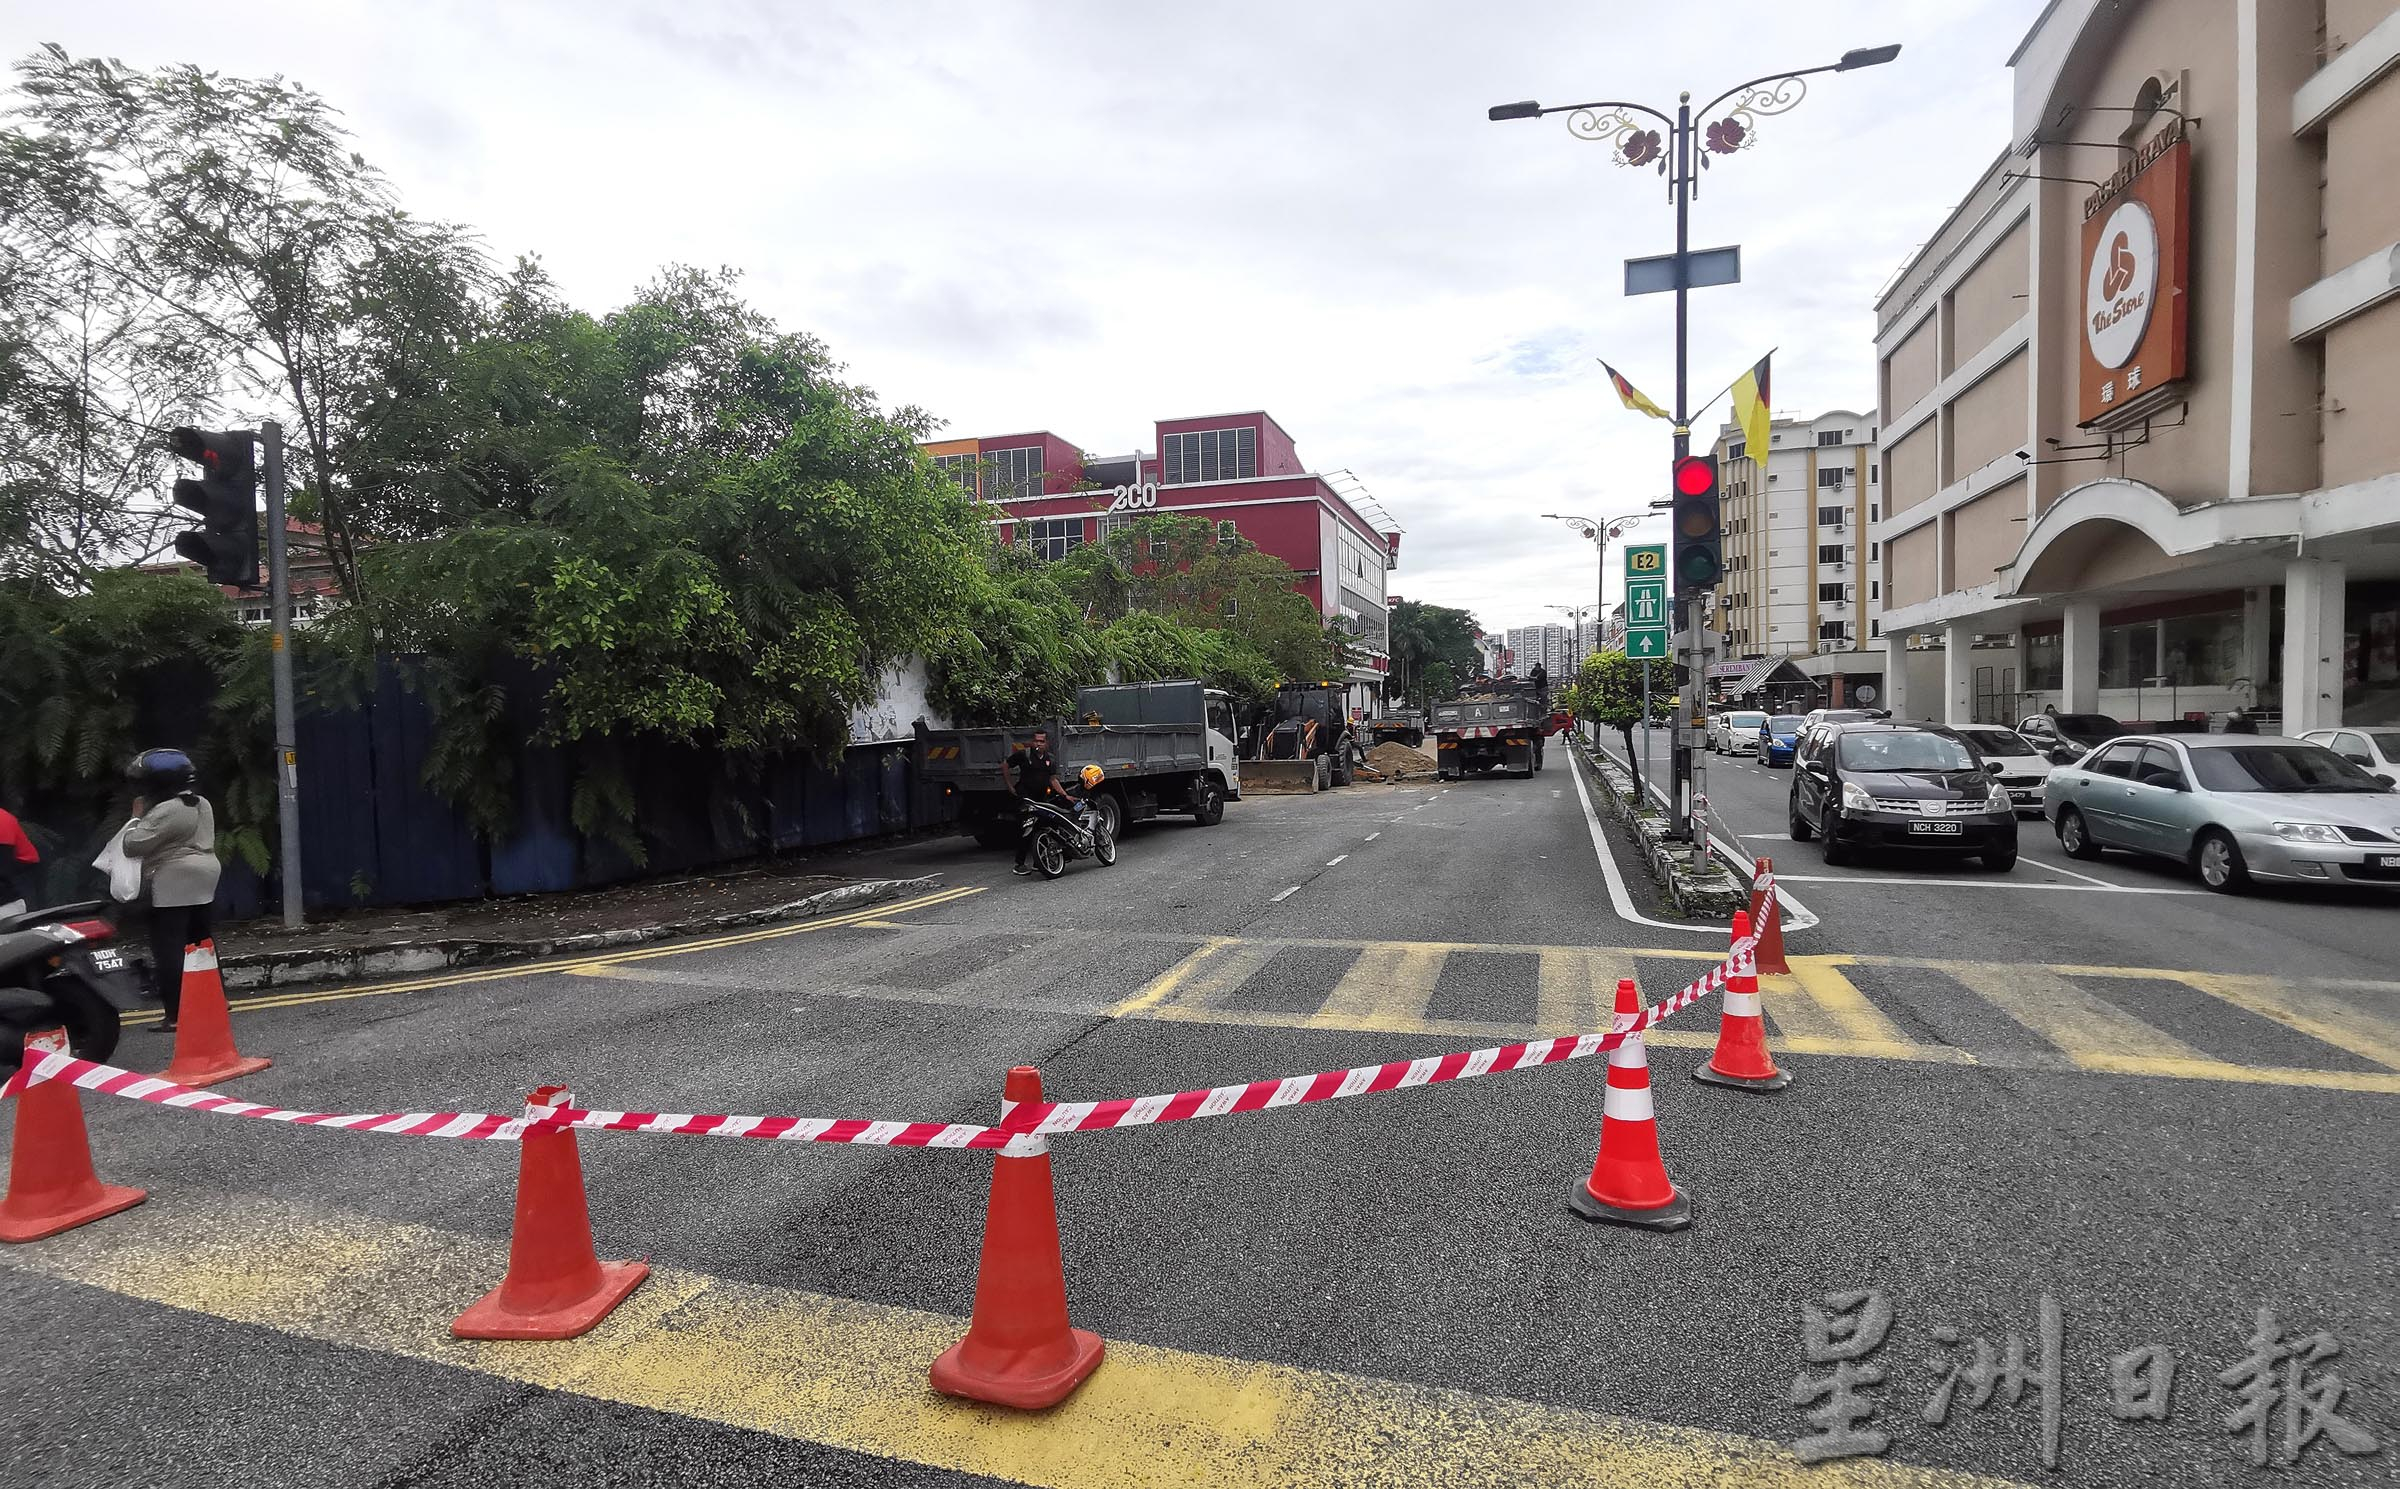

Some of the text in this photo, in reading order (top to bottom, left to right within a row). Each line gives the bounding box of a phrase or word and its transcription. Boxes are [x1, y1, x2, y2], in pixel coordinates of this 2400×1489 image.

[2092, 290, 2145, 335] The Store
[1637, 554, 1654, 569] E2
[1474, 707, 1482, 717] A
[1913, 823, 1957, 832] NCH 3220
[95, 958, 124, 971] 7547
